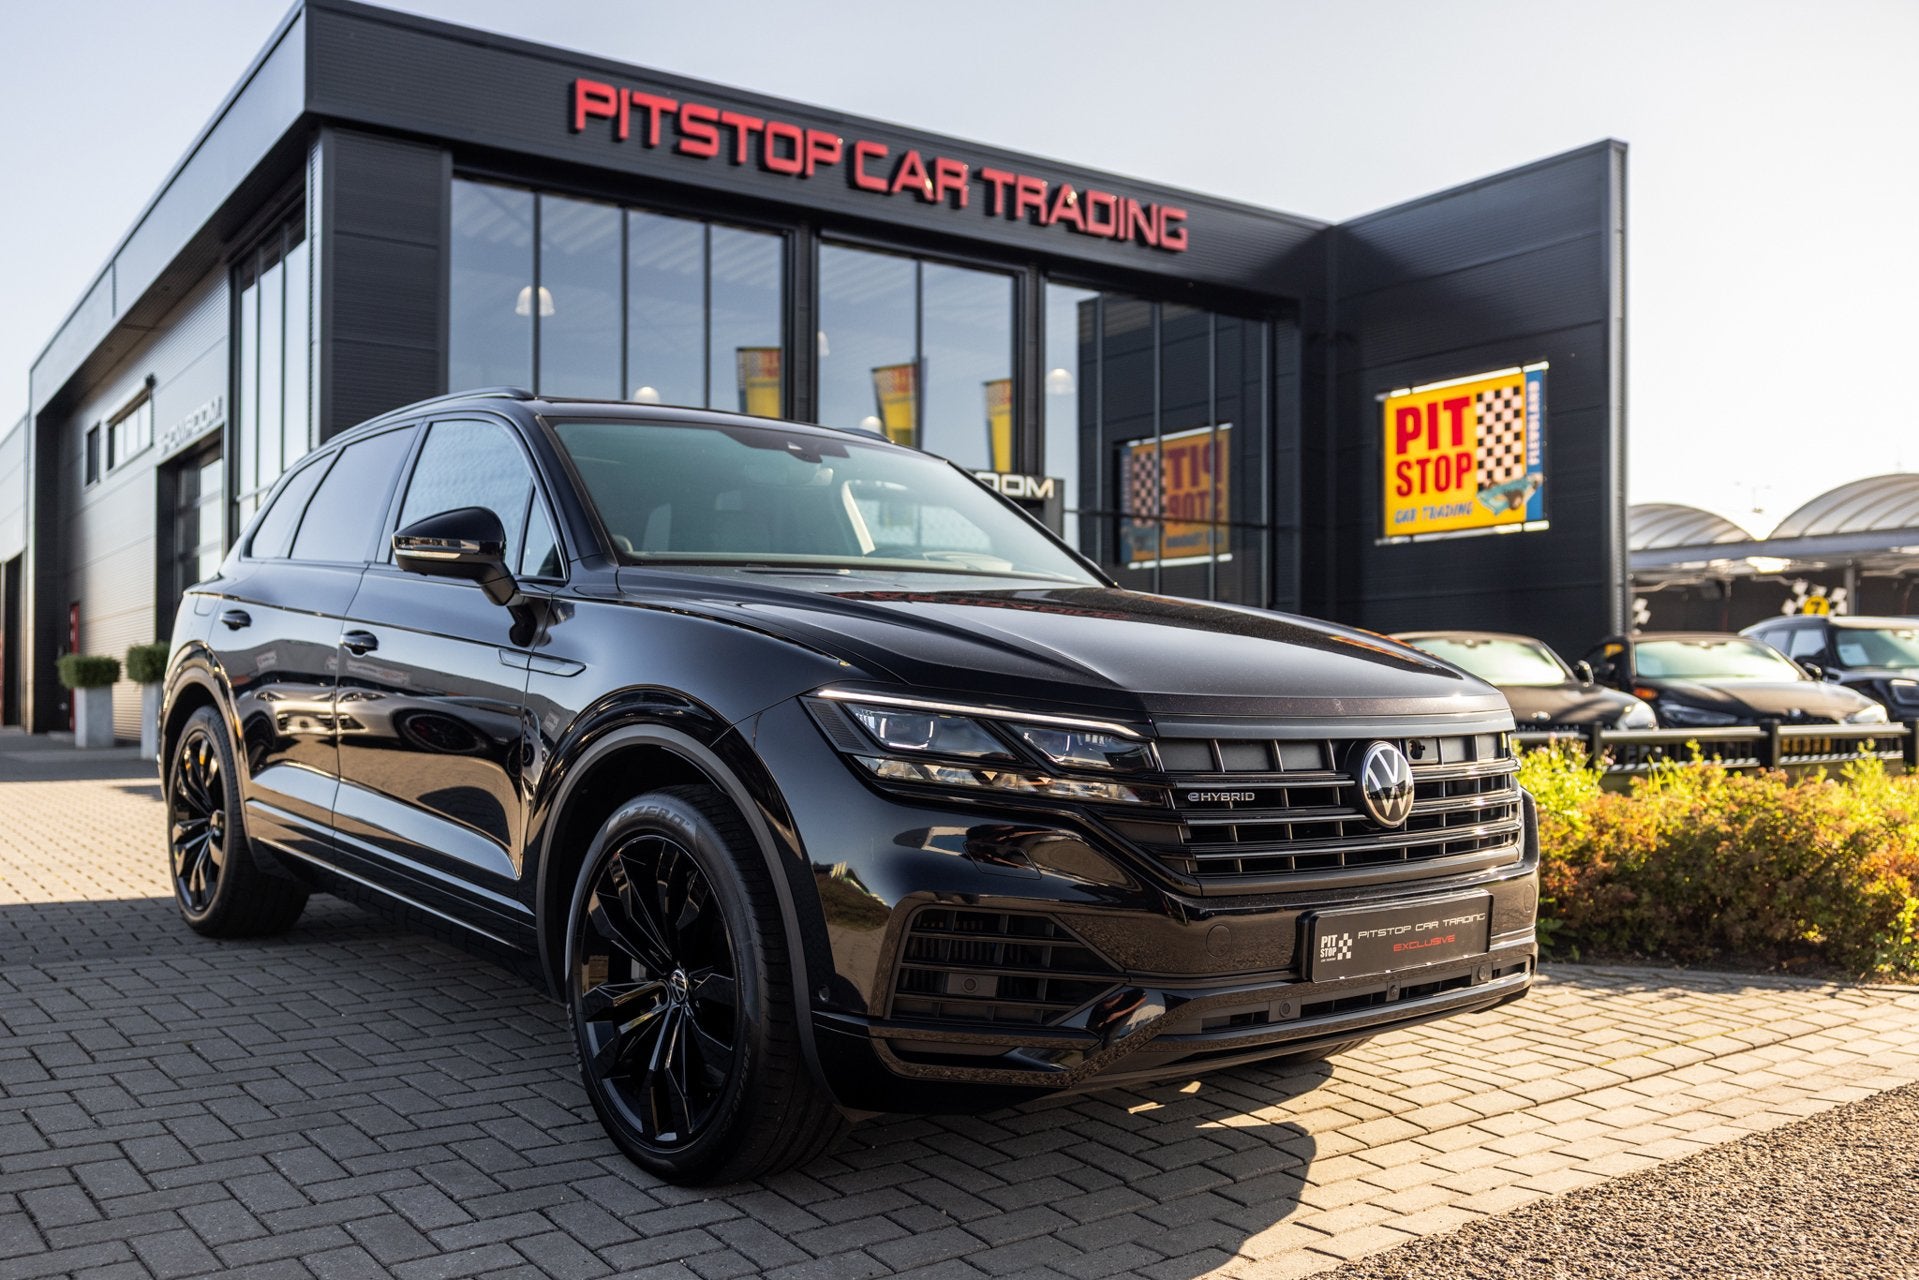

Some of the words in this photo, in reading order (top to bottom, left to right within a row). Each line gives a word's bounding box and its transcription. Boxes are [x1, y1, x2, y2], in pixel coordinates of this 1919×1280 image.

[573, 77, 843, 179] PITSTOP
[853, 141, 969, 209] CAR
[980, 166, 1189, 252] TRADING
[1396, 396, 1471, 455] PIT
[1396, 452, 1473, 498] STOP
[1395, 508, 1417, 524] CAR
[1423, 501, 1474, 521] TRADING
[1358, 925, 1412, 940] PITSTOP
[1415, 920, 1440, 932] CAR
[1442, 912, 1486, 927] TRADING
[1320, 947, 1338, 958] STOP
[1321, 934, 1338, 949] PIT
[1393, 934, 1456, 952] EXCLUSIVE
